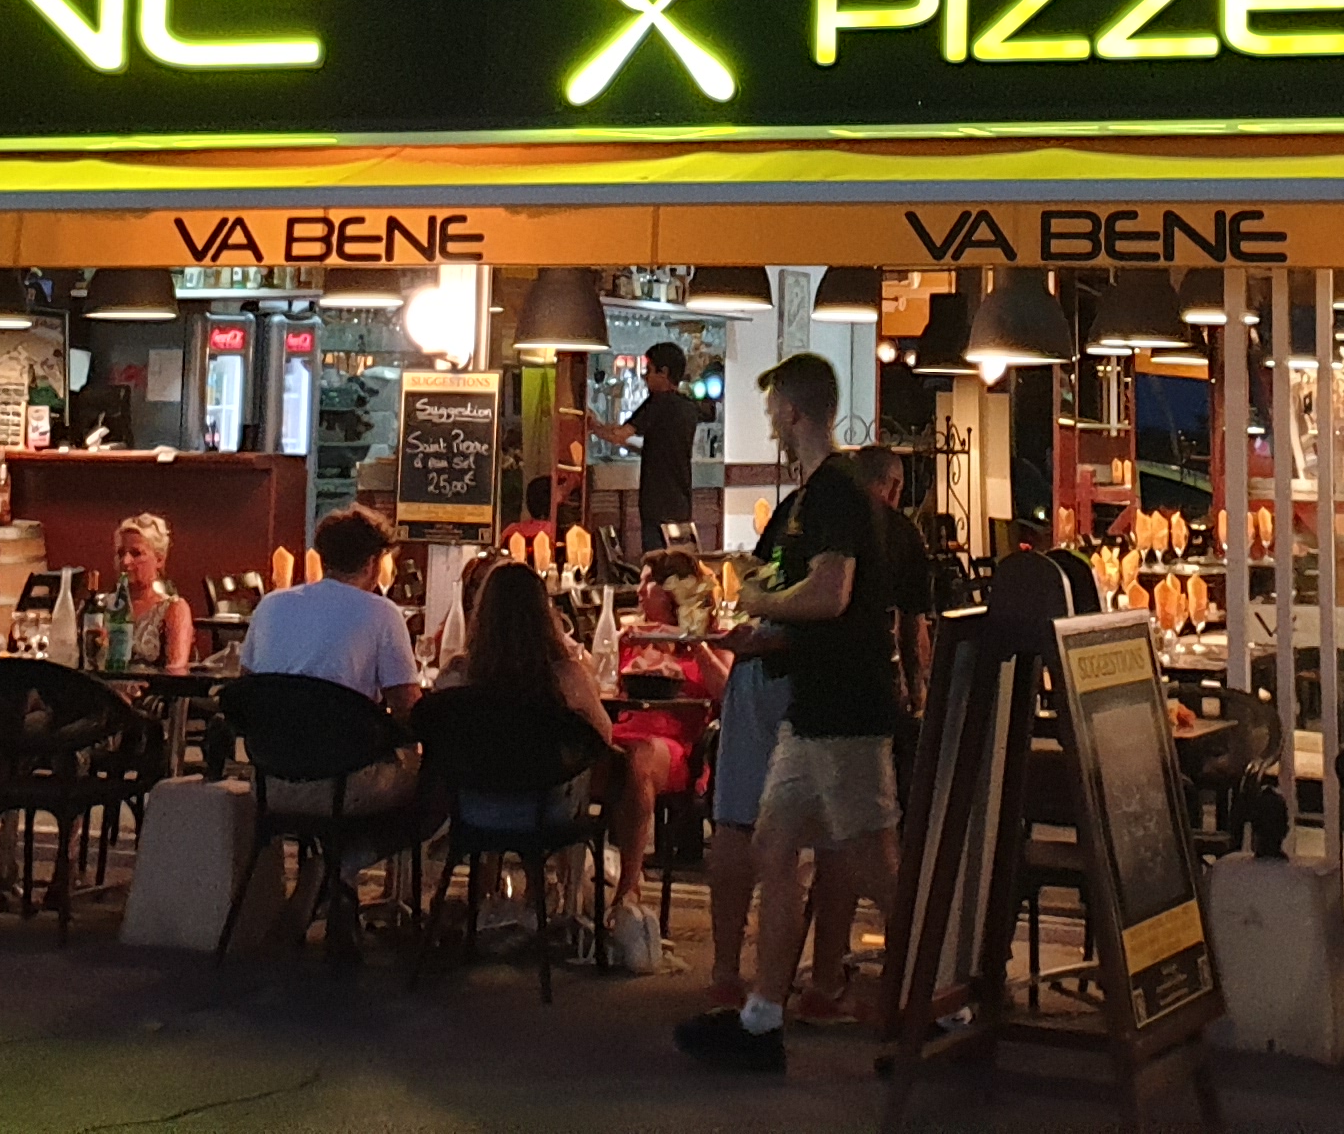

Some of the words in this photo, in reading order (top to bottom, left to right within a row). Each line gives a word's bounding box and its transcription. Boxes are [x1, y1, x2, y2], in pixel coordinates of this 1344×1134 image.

[174, 217, 264, 263] VA
[284, 214, 485, 263] BENE
[904, 209, 1018, 262] VA
[1040, 209, 1288, 263] BENE
[411, 376, 491, 388] SUGGESTIONS
[415, 398, 492, 422] Suggestion
